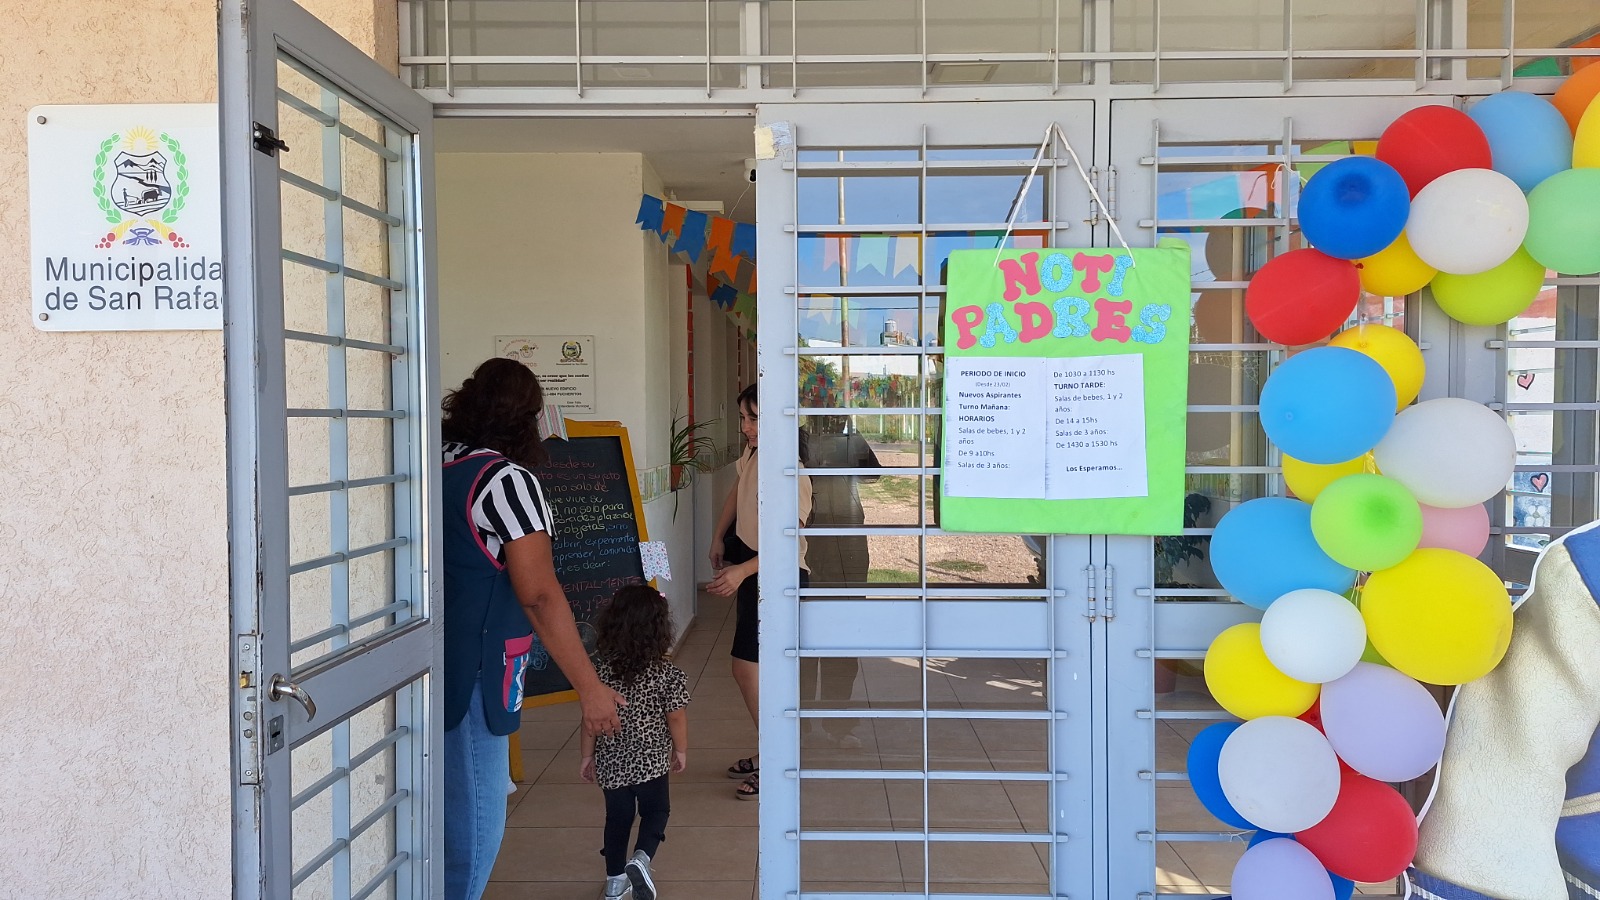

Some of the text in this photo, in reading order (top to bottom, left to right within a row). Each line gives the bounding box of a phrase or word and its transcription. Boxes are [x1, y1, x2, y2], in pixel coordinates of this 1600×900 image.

[45, 256, 222, 287] Municipalida
[998, 251, 1134, 302] NOTI
[45, 285, 222, 311] de San Rafa
[951, 296, 1172, 349] PADRES
[960, 370, 1027, 378] PERIODO DE INICIO
[1064, 370, 1082, 378] 1030
[1089, 369, 1106, 377] 1130
[1053, 381, 1106, 390] TURNO TARDE:
[958, 391, 1022, 400] Nuevos Aspirantes
[980, 403, 1011, 411] Mañana:
[1054, 405, 1073, 413] años:
[958, 415, 995, 423] HORARIOS
[986, 427, 1009, 436] bebes,
[1055, 429, 1073, 437] Salas
[1073, 429, 1082, 437] de
[1089, 428, 1109, 436] años:
[958, 437, 975, 445] años
[1055, 441, 1065, 449] De
[1066, 441, 1084, 449] 1430
[1091, 440, 1109, 448] 1530
[958, 449, 968, 457] De
[545, 455, 579, 469] desde
[957, 461, 975, 469] Salas
[976, 461, 985, 469] de
[554, 484, 567, 492] no
[570, 482, 592, 491] solo
[563, 505, 577, 515] no
[580, 504, 600, 515] solo
[601, 503, 624, 517] para
